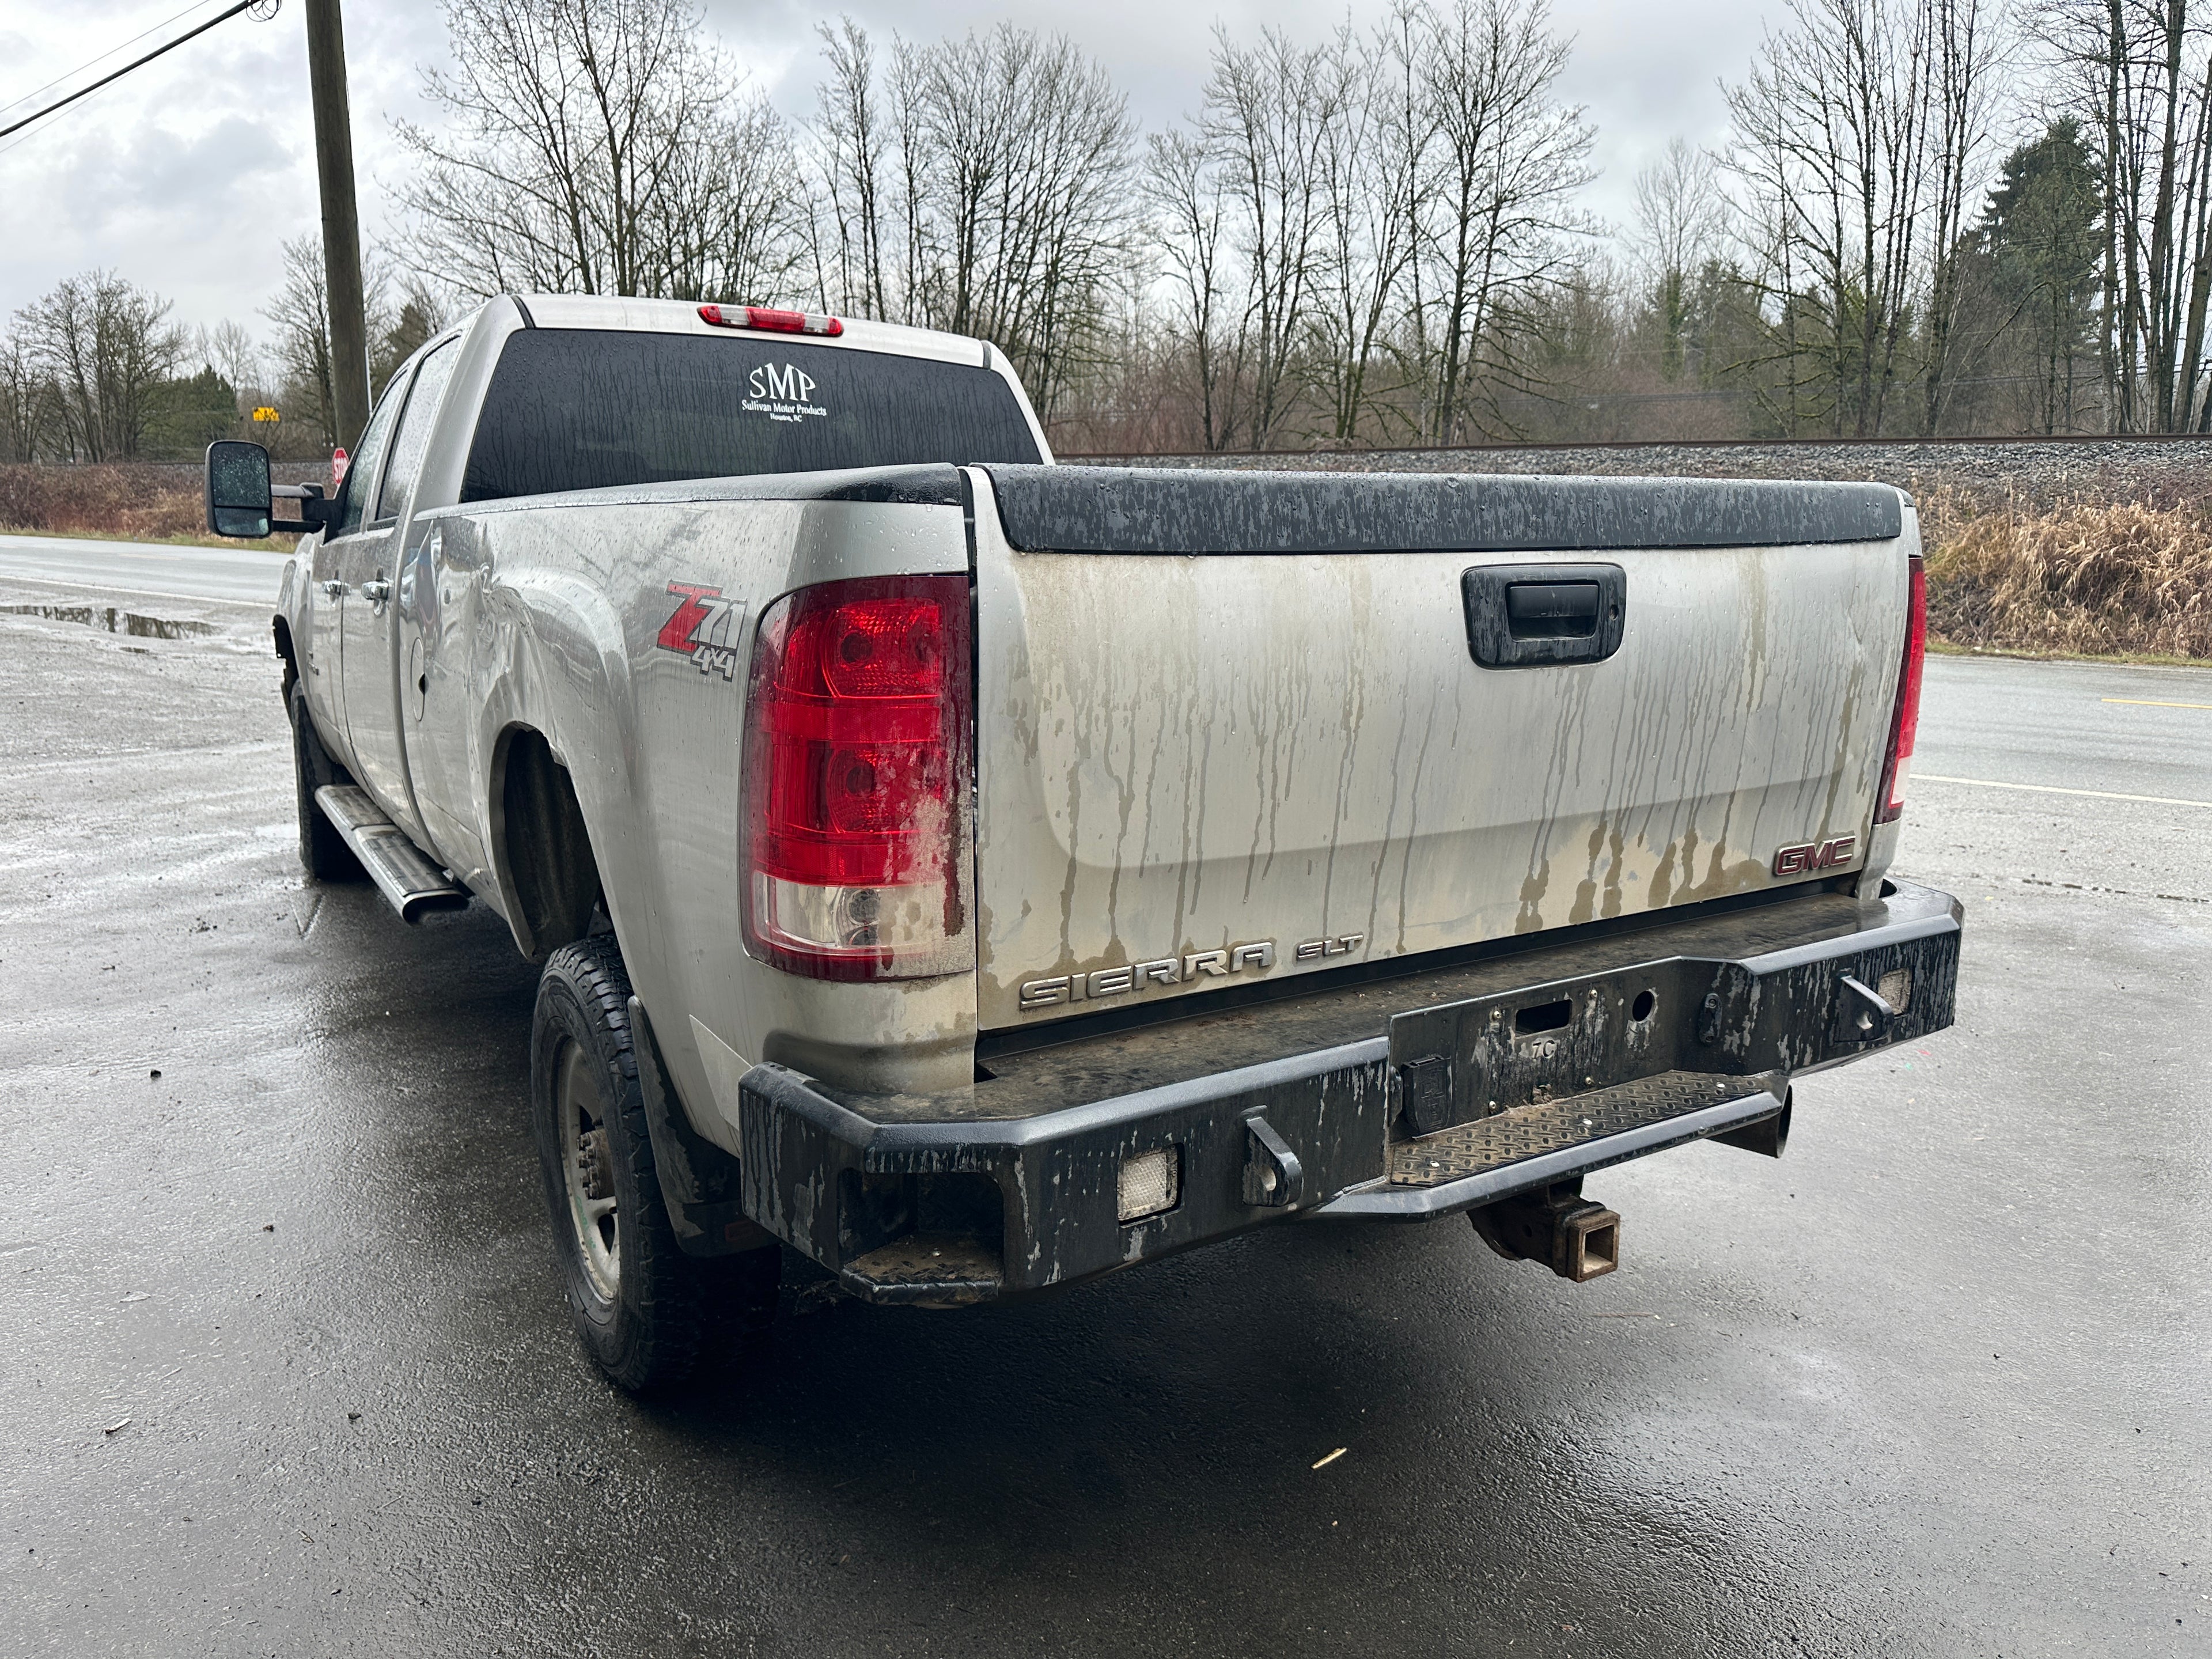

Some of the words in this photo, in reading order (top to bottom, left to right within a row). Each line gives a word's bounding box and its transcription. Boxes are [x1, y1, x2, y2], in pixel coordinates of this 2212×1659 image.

[749, 362, 816, 402] SMP
[741, 399, 772, 411] Sullivan
[773, 402, 795, 413] Motor
[796, 404, 827, 416] Products
[657, 580, 748, 656] Z71
[1772, 835, 1856, 876] GMC
[1019, 942, 1273, 1010] SIERRA
[1297, 934, 1363, 961] SLT
